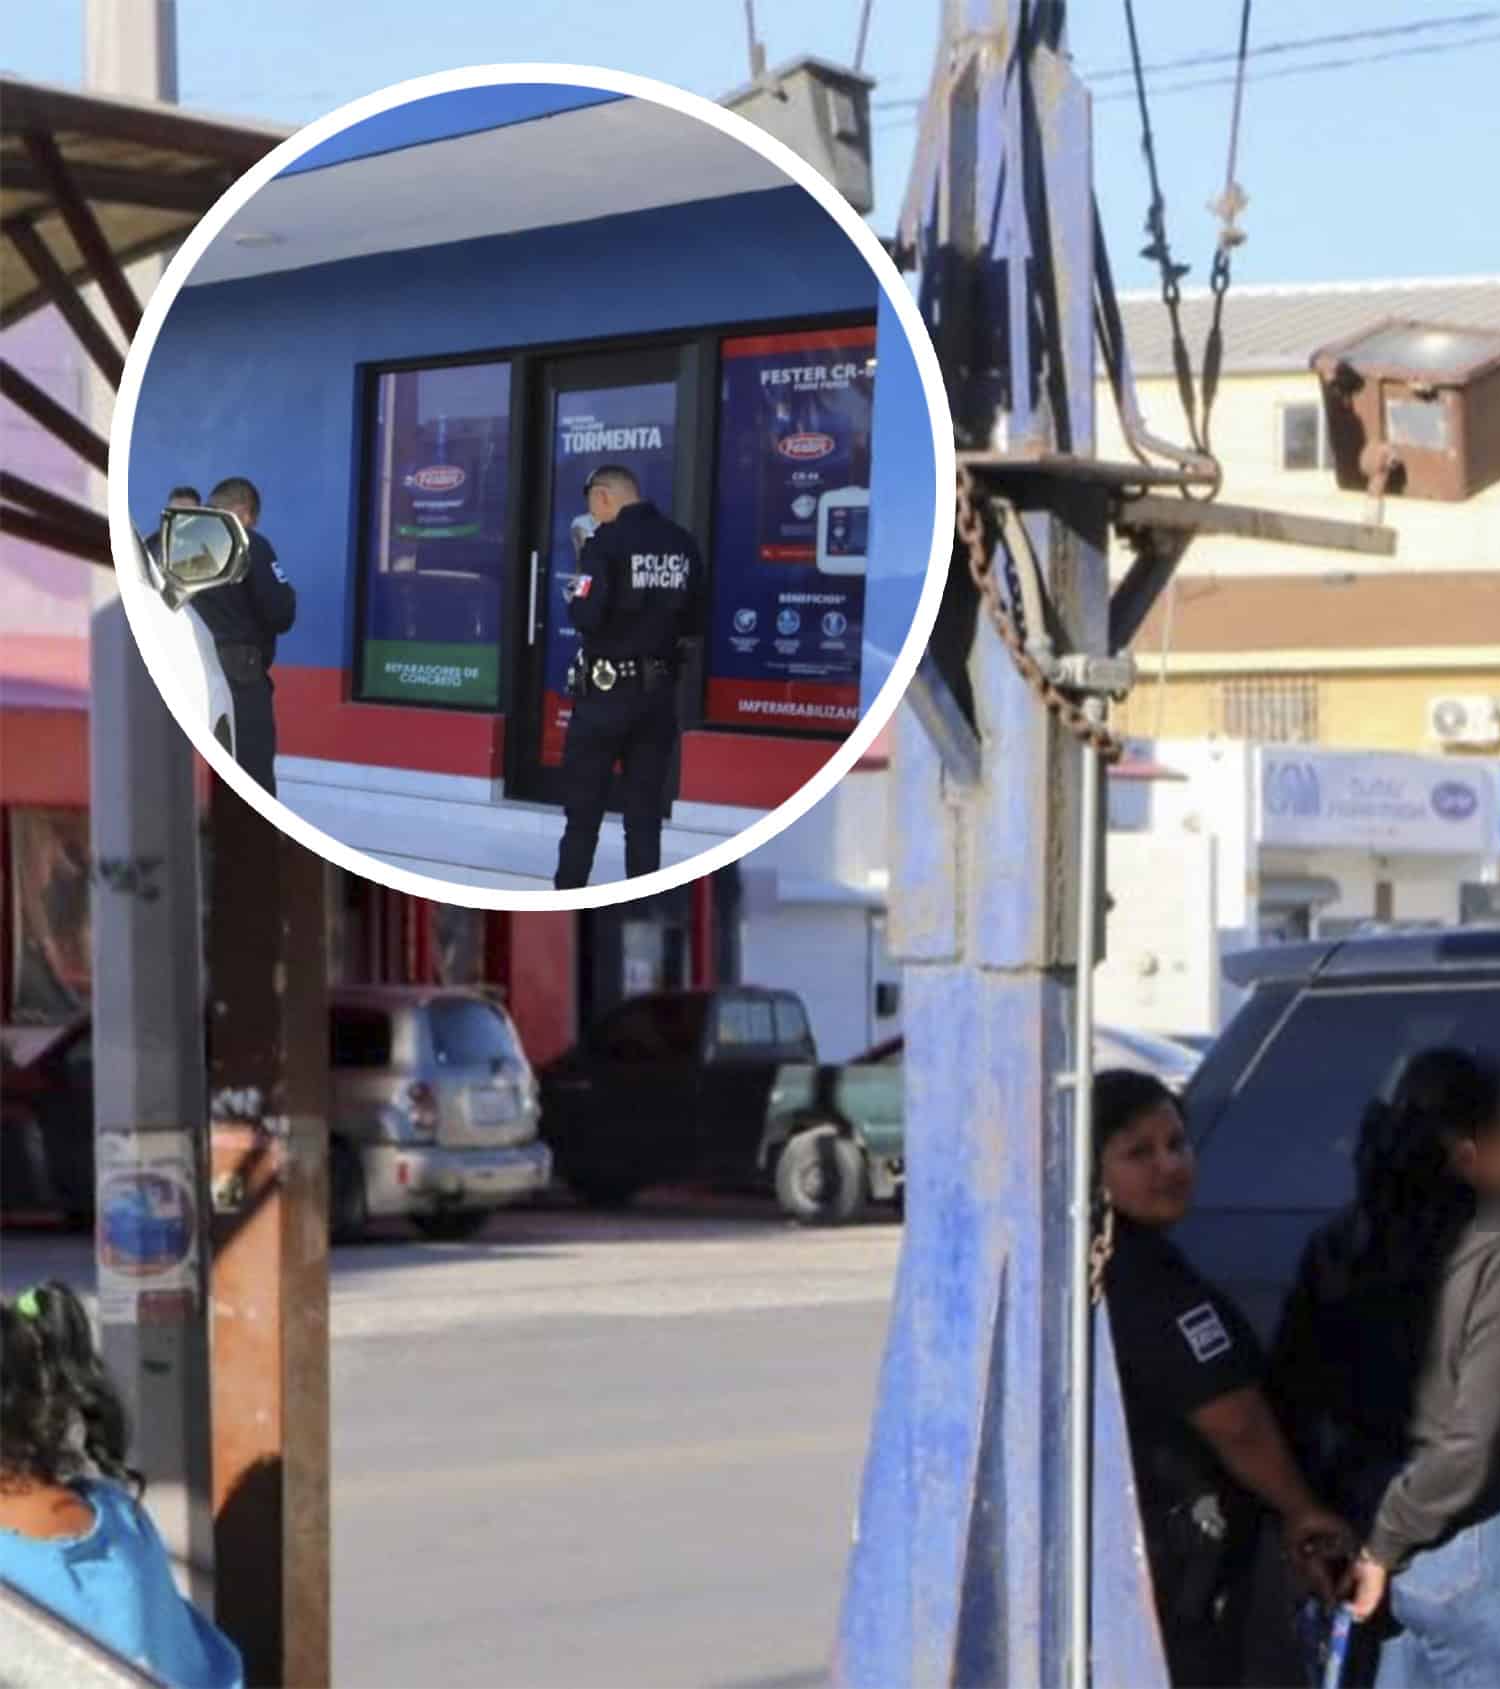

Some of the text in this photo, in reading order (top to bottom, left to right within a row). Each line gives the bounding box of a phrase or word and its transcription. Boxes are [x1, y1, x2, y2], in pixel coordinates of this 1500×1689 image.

[760, 365, 827, 385] FESTER
[561, 427, 662, 453] TORMENTA
[737, 699, 859, 720] IMPERMEABILIZAN
